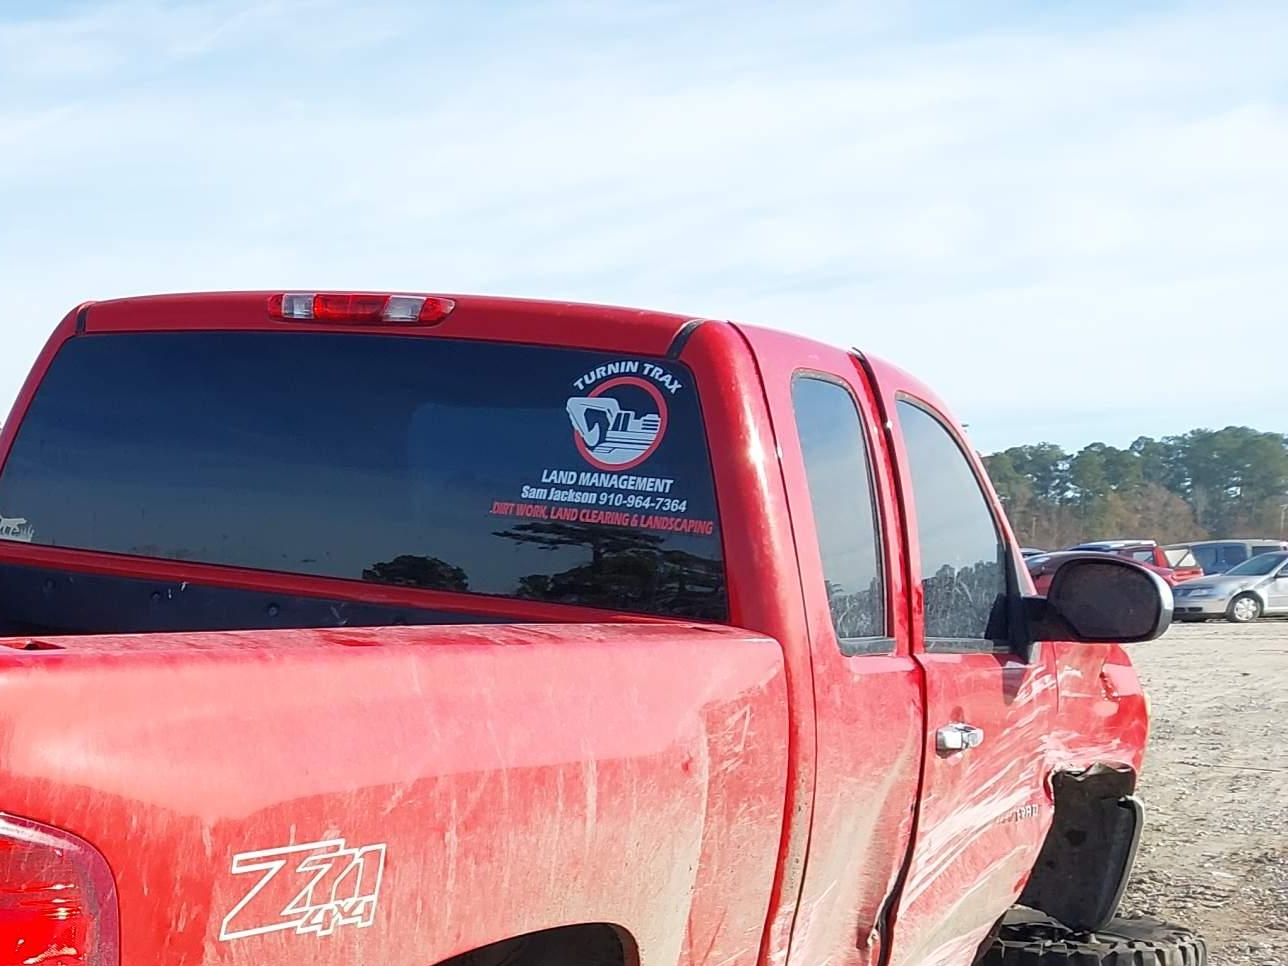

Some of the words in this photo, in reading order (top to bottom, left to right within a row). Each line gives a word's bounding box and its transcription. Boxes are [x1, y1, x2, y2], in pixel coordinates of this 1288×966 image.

[573, 361, 639, 391] TURNIN
[642, 363, 683, 394] TRAX
[541, 469, 577, 485] LAND
[578, 472, 674, 493] MANAGEMENT
[520, 485, 548, 500] Sam
[547, 488, 597, 505] Jackson
[598, 492, 688, 513] 910-964-7364
[493, 501, 515, 515] DIRT
[515, 503, 549, 519] WORK,
[550, 506, 579, 521] LAND
[579, 508, 630, 526] CLEARING
[630, 514, 639, 527] &
[639, 515, 713, 535] LANDSCAPING
